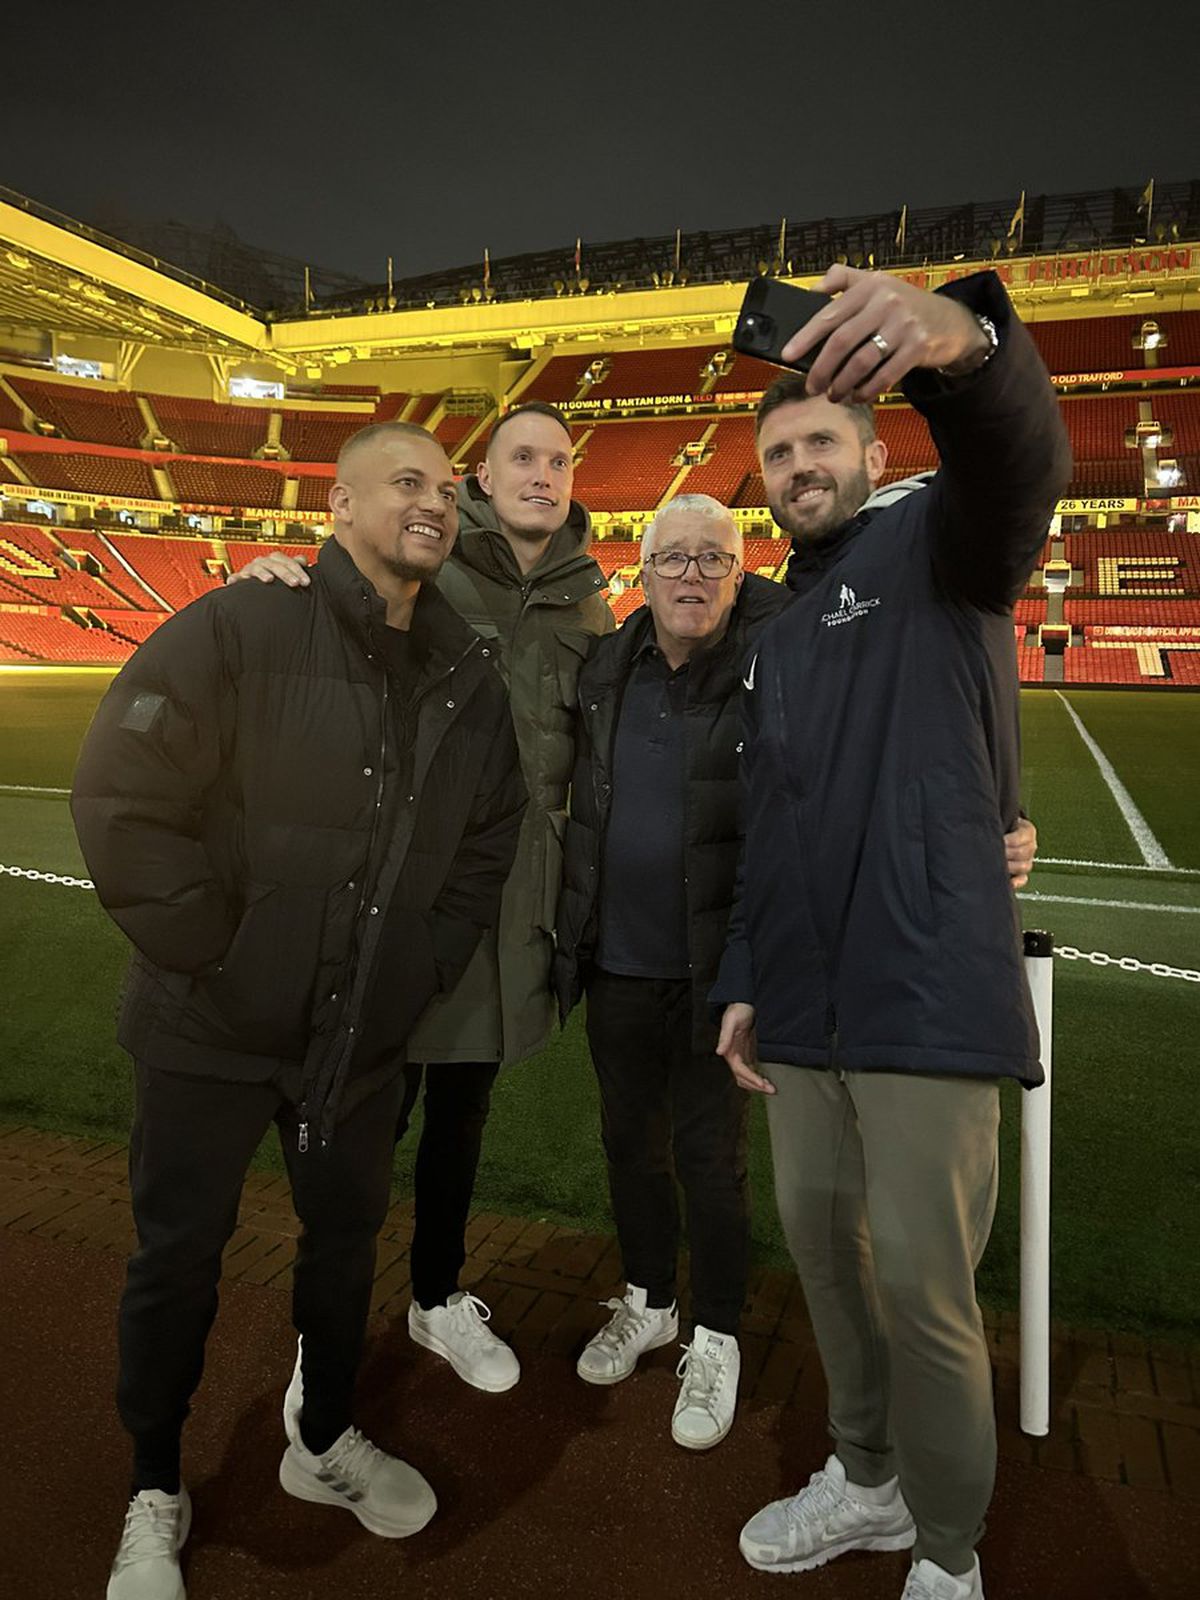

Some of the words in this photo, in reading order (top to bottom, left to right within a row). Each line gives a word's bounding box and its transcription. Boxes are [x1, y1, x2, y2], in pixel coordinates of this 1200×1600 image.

[1028, 247, 1192, 284] FERGUSON
[1058, 373, 1077, 384] OLD
[1078, 371, 1124, 383] TRAFFORD
[569, 400, 601, 410] GOVAN
[615, 397, 654, 407] TARTAN
[655, 395, 683, 404] BORN
[1060, 501, 1077, 510] 26
[1081, 499, 1126, 510] YEARS
[245, 507, 327, 521] MANCHESTER
